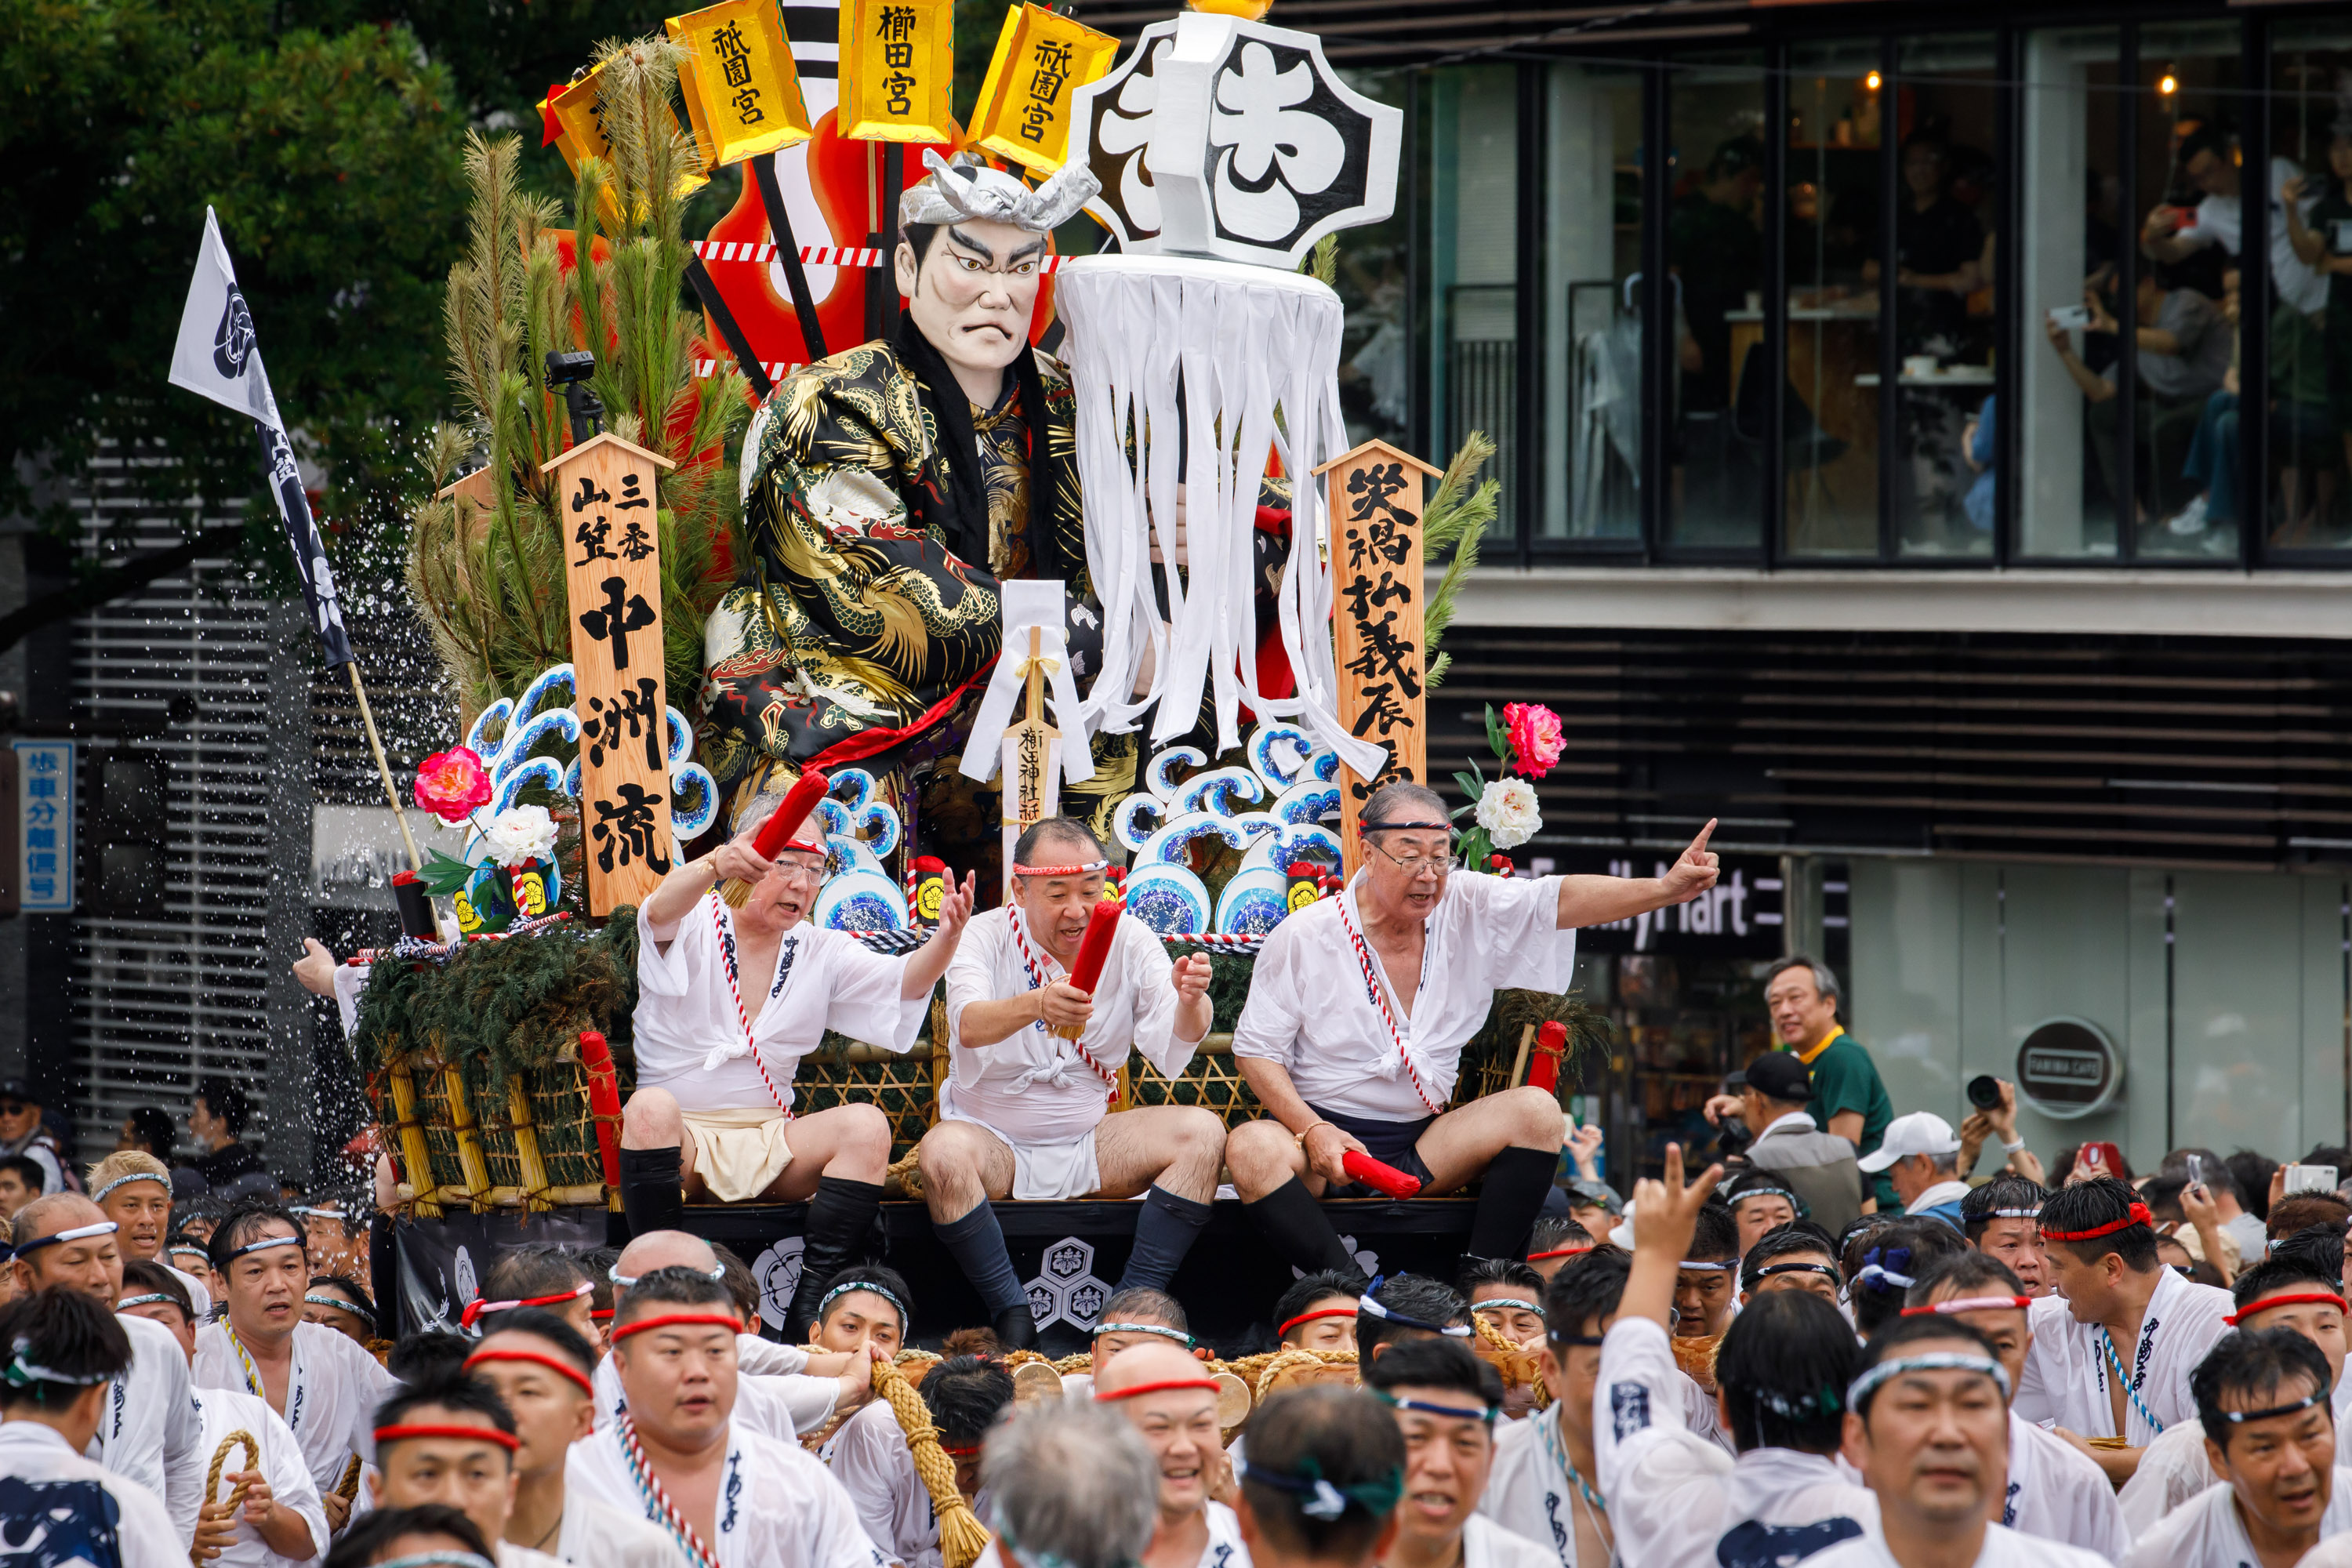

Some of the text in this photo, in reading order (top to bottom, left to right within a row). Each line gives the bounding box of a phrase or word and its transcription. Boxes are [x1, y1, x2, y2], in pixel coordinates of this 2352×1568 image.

[711, 19, 765, 125] 祇園宮
[876, 5, 916, 115] 櫛田宮
[1020, 39, 1073, 143] 祇園宮
[572, 477, 619, 568] 山笠
[615, 474, 655, 563] 三番
[579, 576, 671, 877] 中洲流
[27, 751, 58, 900] 歩車分離信号
[1018, 727, 1043, 835] 櫛田神社祇
